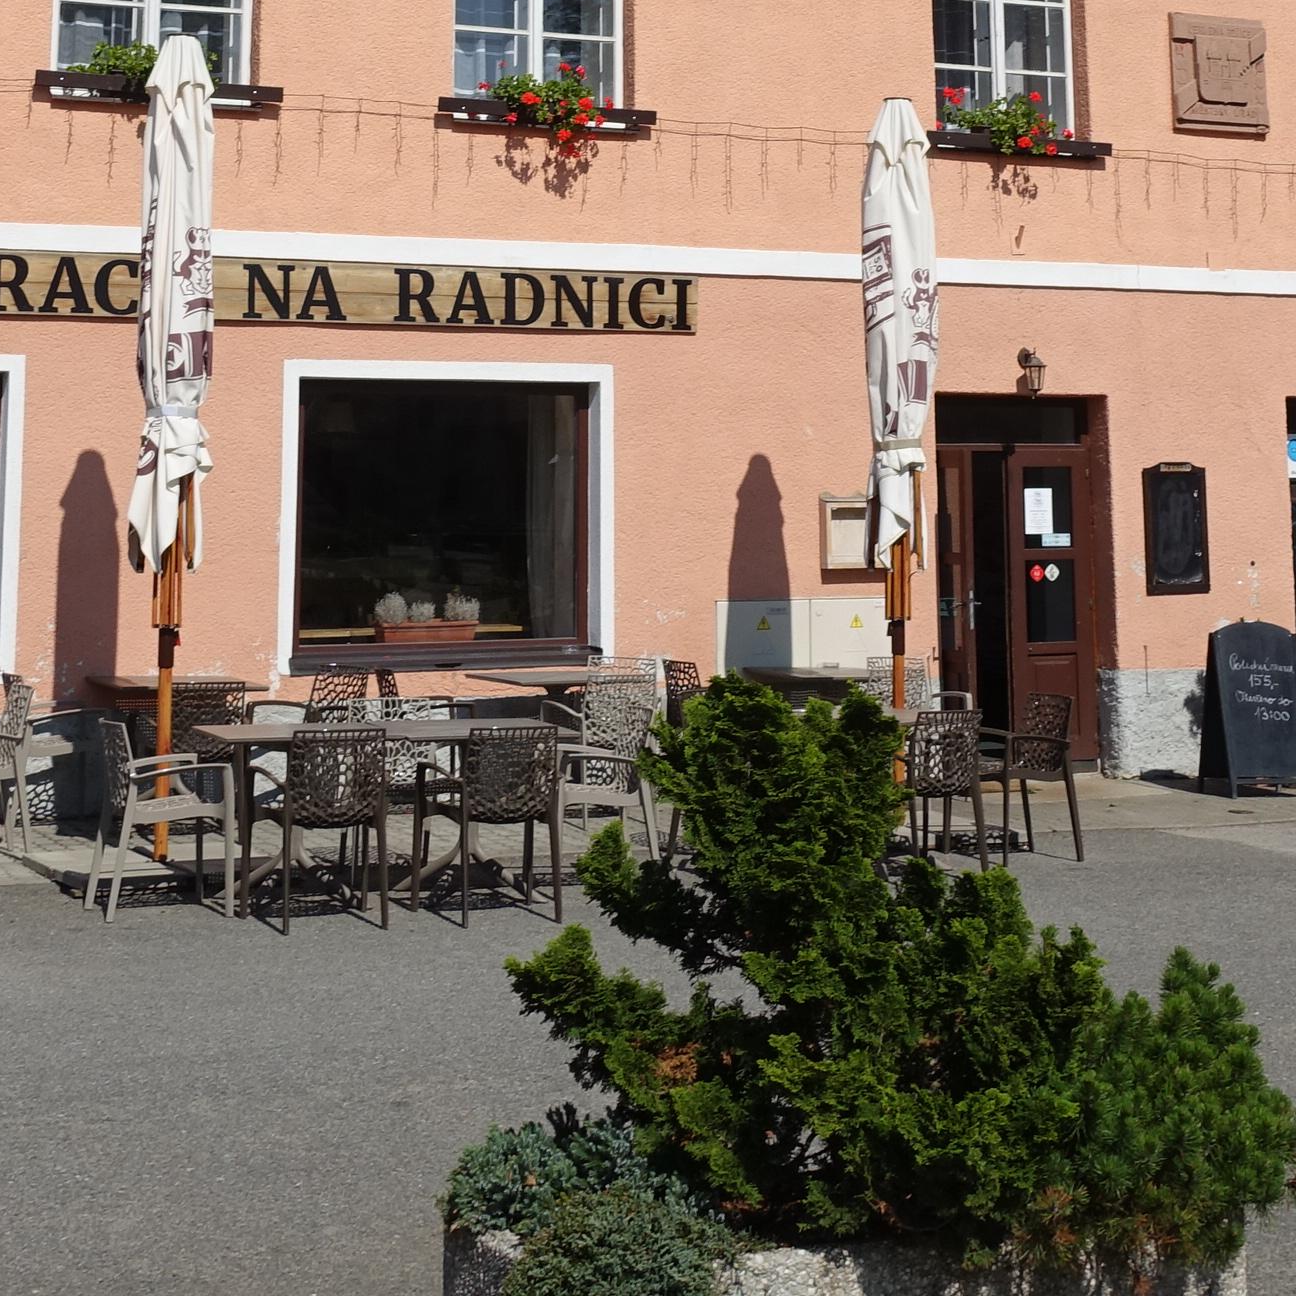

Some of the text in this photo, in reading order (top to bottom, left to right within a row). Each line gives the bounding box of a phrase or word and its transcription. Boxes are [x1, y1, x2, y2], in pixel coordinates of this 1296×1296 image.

[242, 263, 347, 321] NA
[394, 267, 693, 331] RADNICI
[1254, 706, 1291, 721] 13:00
